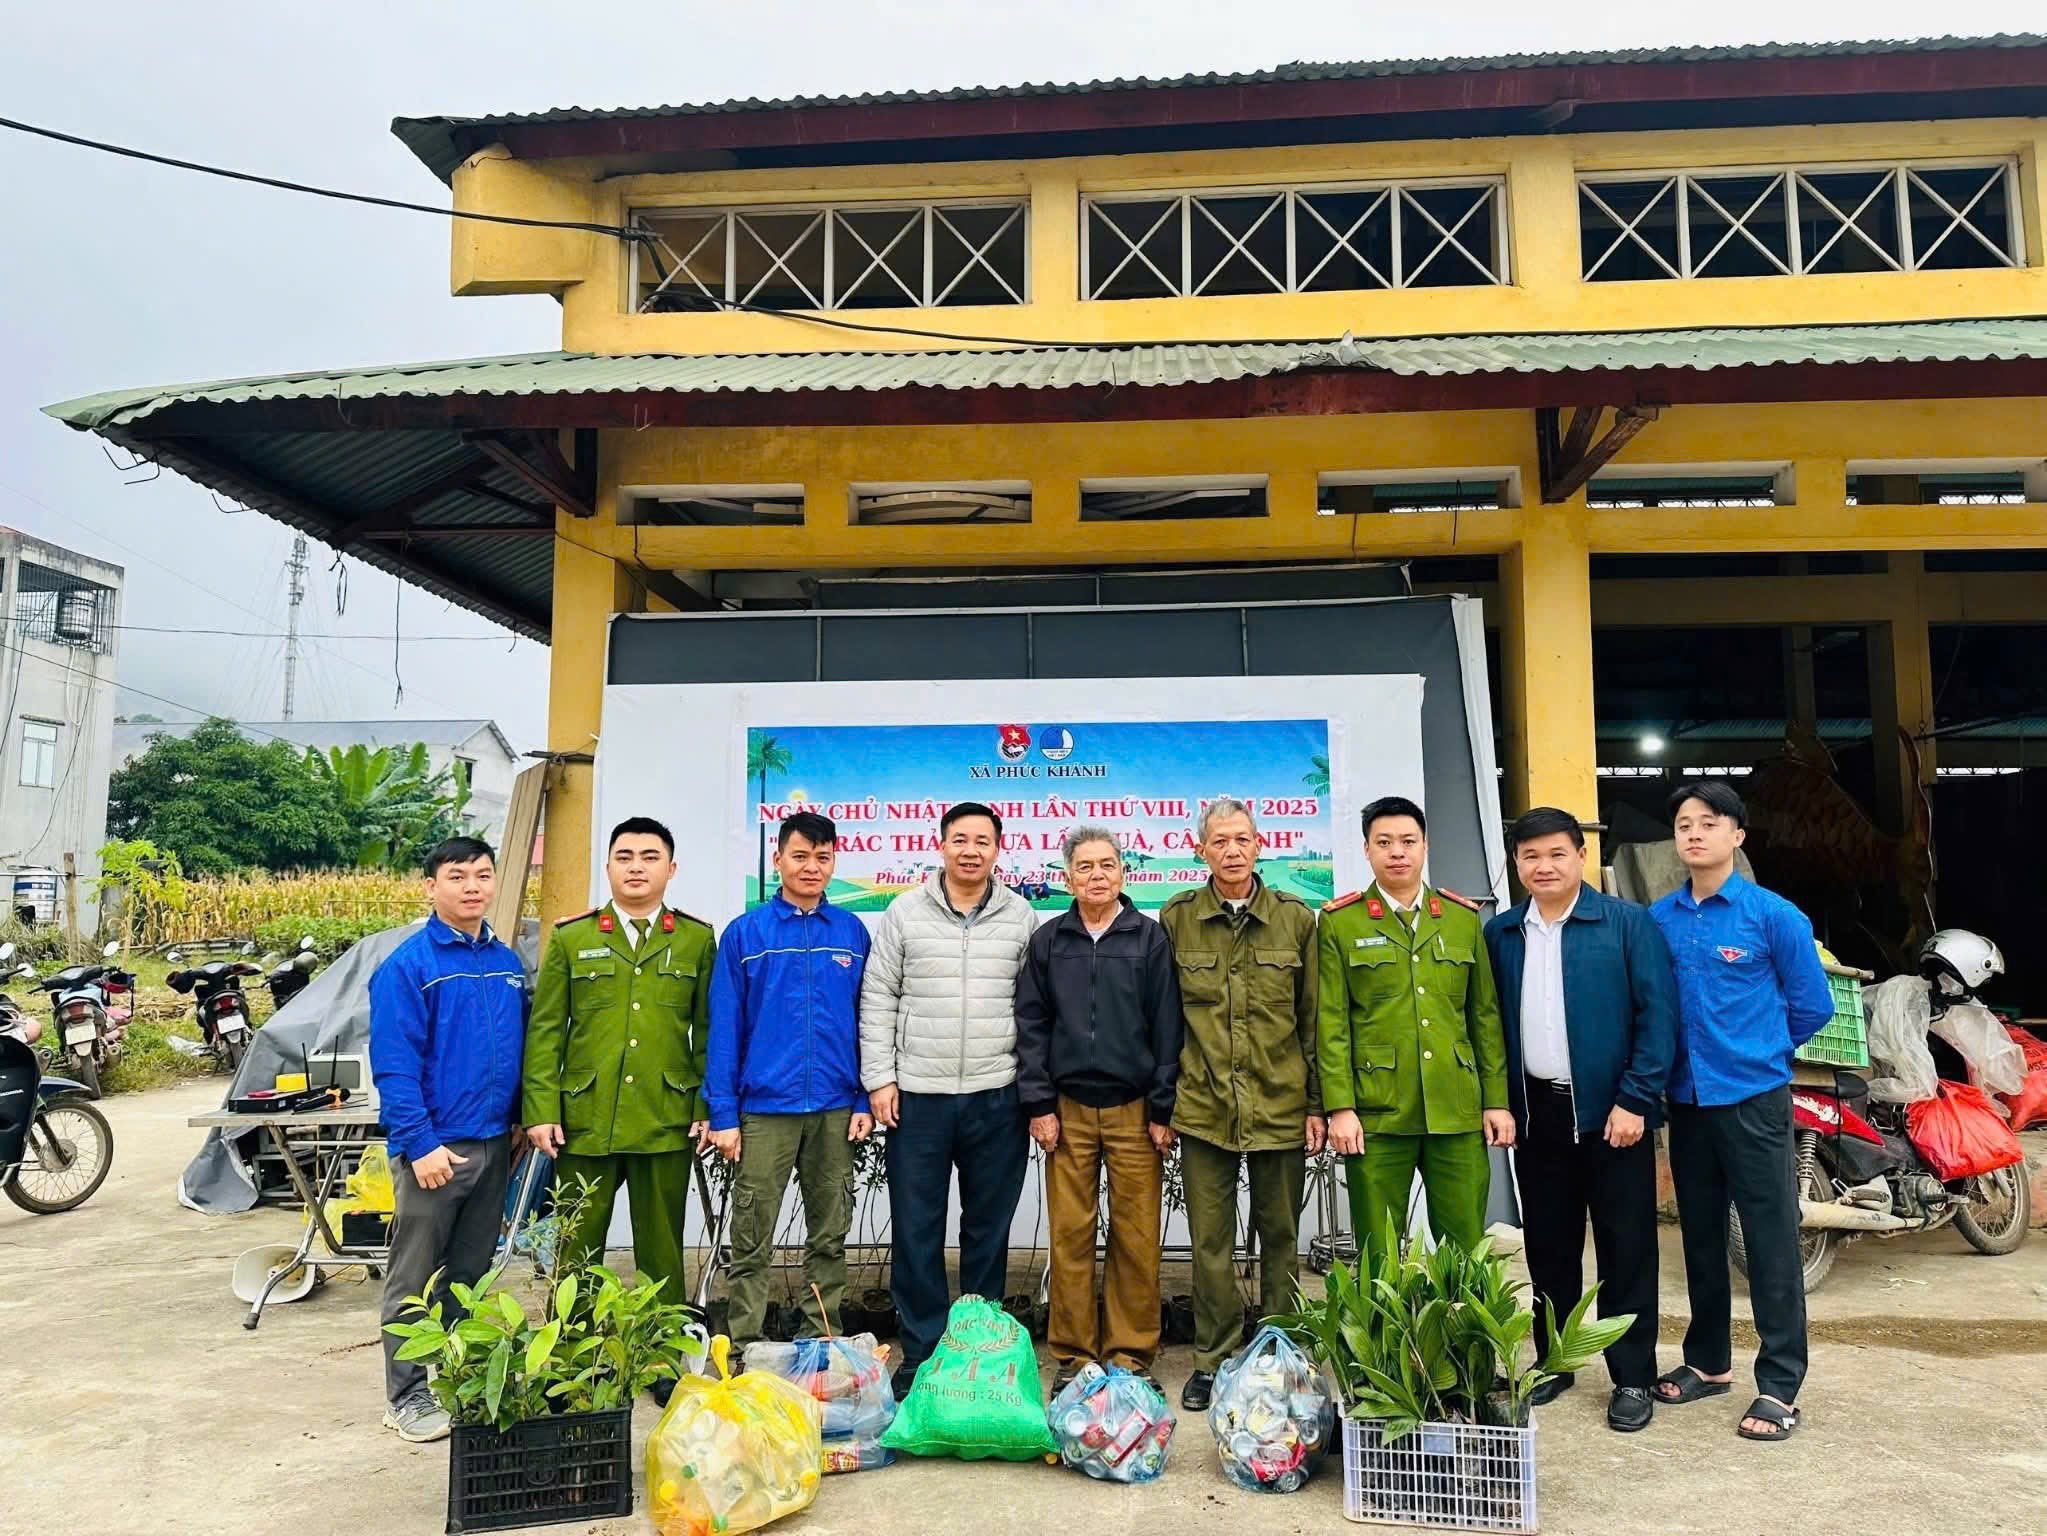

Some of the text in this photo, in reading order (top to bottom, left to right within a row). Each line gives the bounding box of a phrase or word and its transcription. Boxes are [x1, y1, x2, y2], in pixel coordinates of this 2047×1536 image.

[996, 762, 1041, 777] PHÚC
[1047, 761, 1106, 777] KHÁNH
[828, 798, 878, 820] CHỦ
[886, 800, 952, 822] NHẬT
[989, 802, 1024, 818] NH
[1032, 796, 1076, 818] LẦN
[1085, 798, 1139, 818] THỨ
[1142, 800, 1190, 819] VIII,
[1262, 799, 1318, 816] 2025
[833, 831, 883, 852] RÁC
[890, 828, 942, 851] THẢ
[1163, 828, 1196, 849] CÂ
[1169, 869, 1209, 882] 2025
